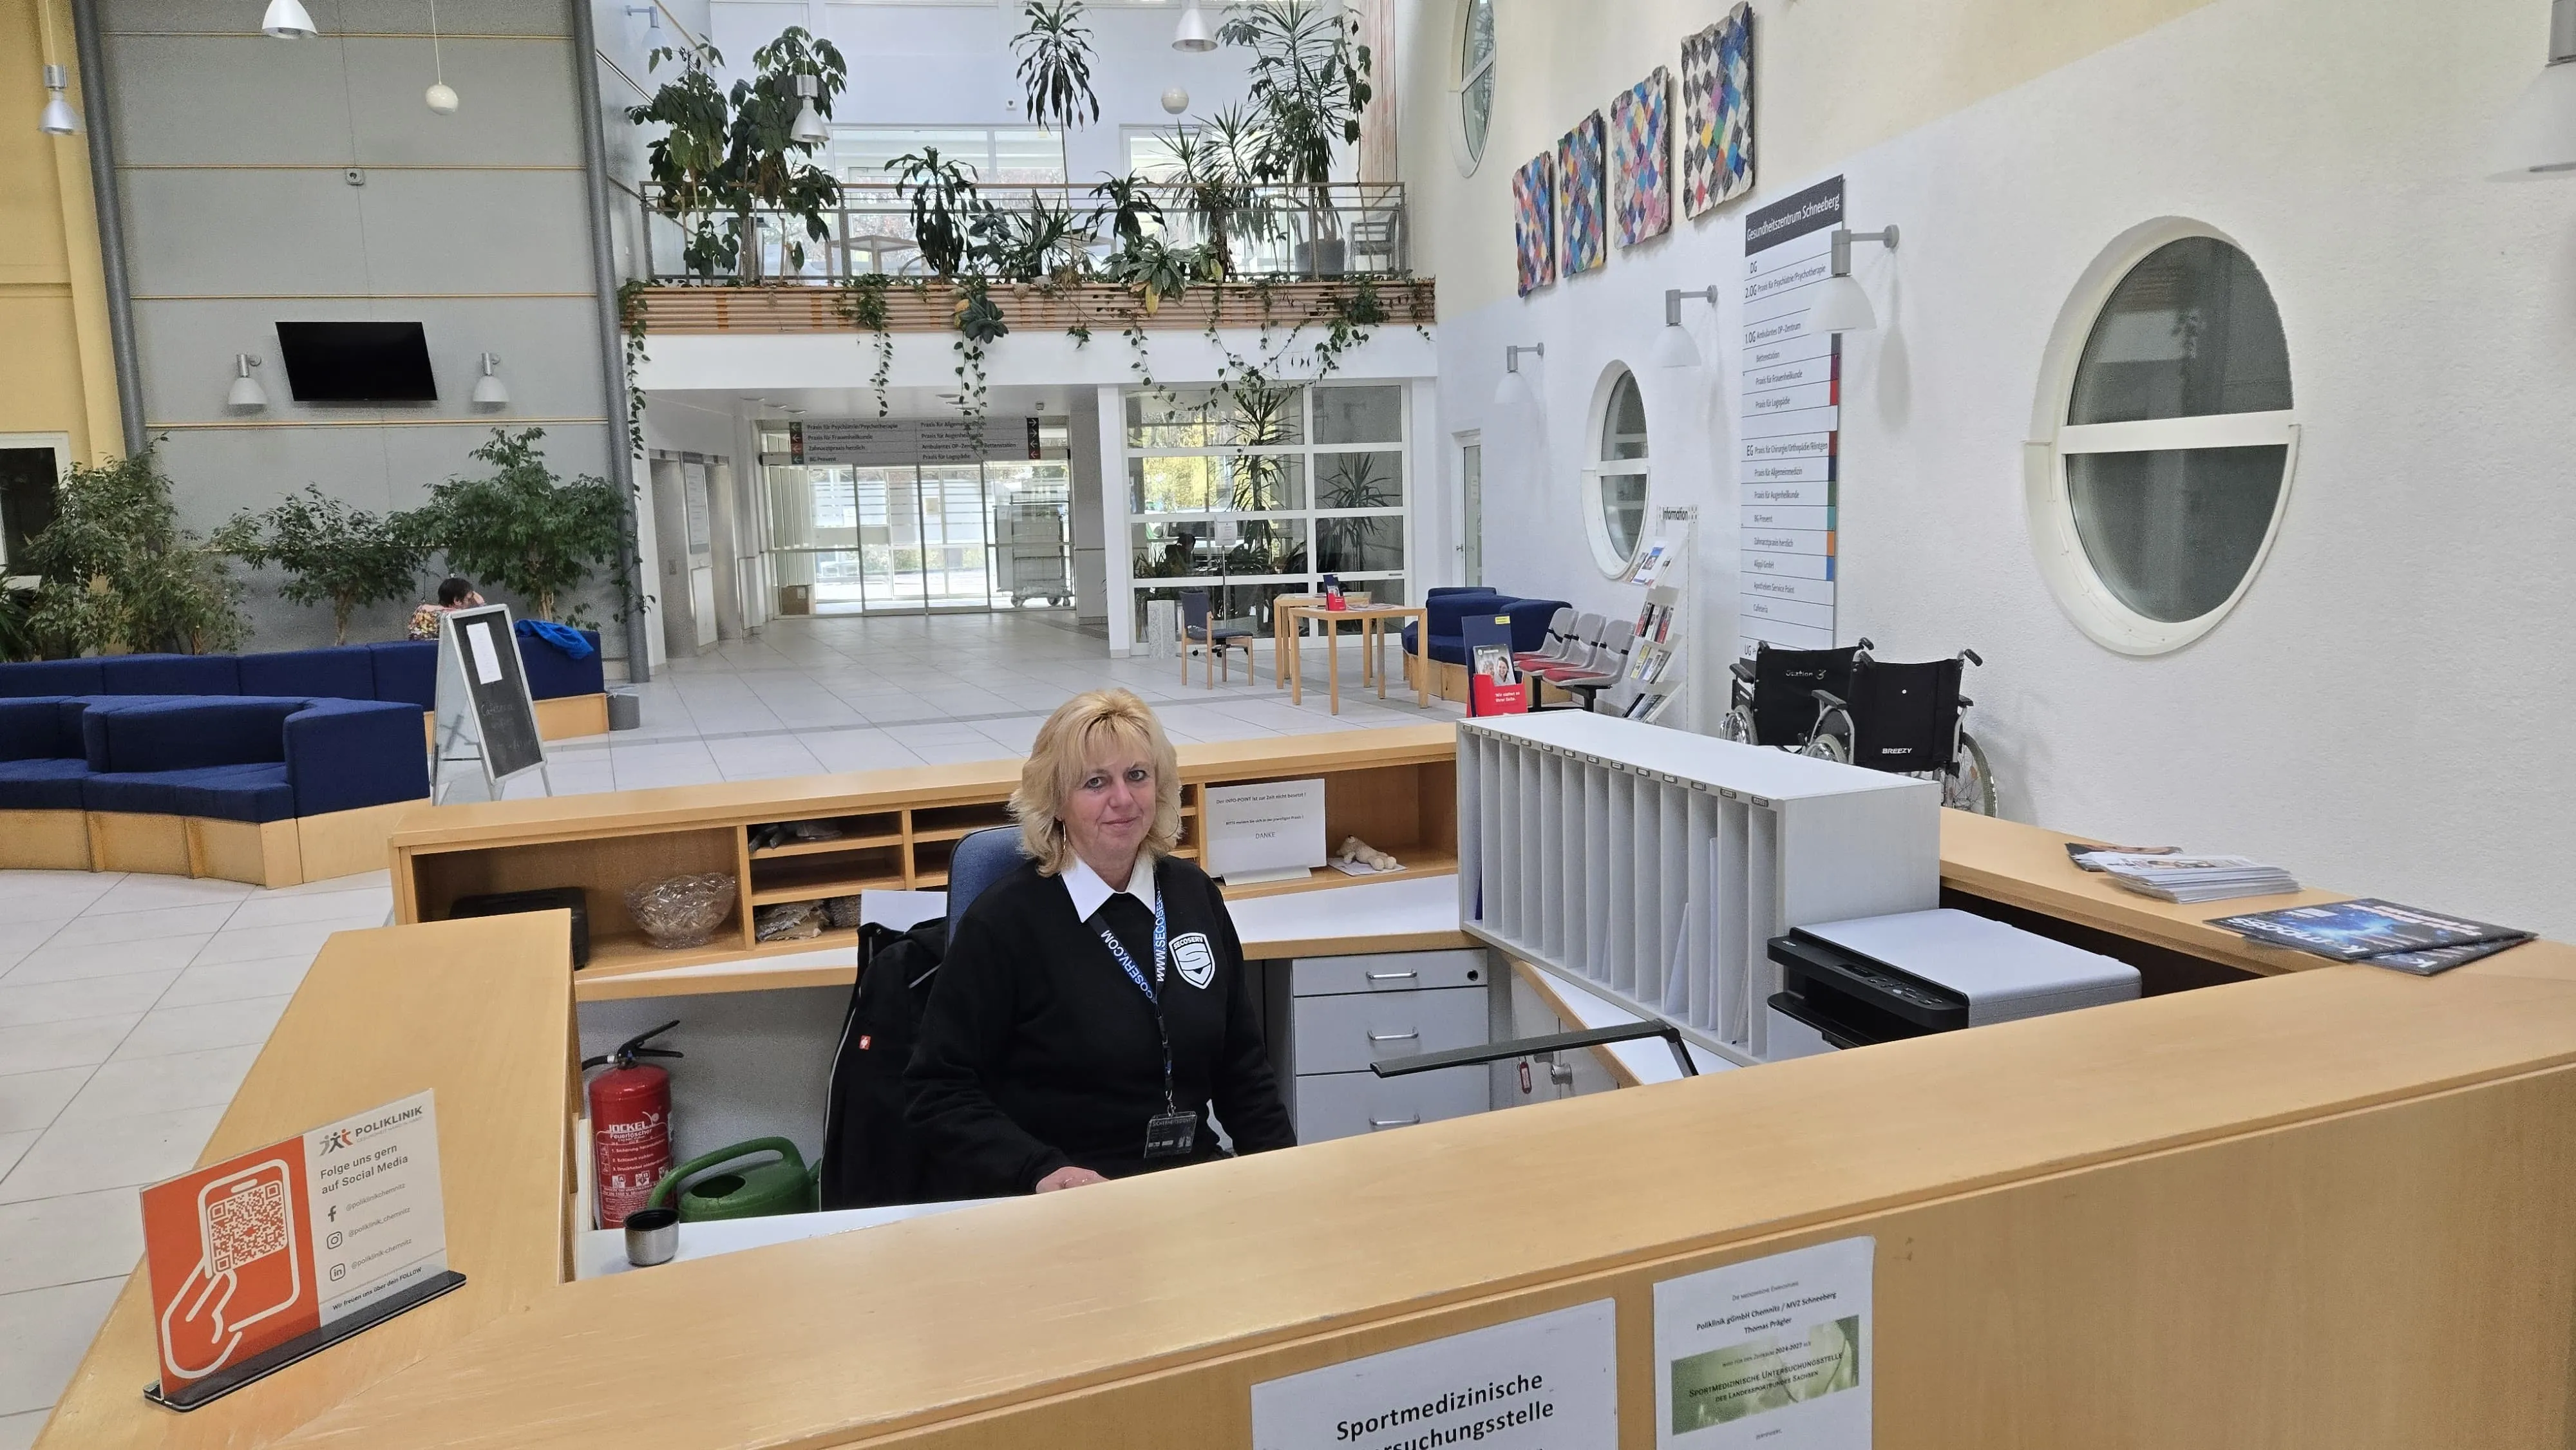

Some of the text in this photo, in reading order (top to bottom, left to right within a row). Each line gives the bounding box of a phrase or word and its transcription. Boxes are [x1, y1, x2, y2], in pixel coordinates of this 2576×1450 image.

[1747, 193, 1839, 241] Gesundheitszentrum Schneeberg
[1750, 261, 1757, 274] DG
[1745, 285, 1757, 298] 2.OG
[1745, 331, 1756, 344] 1.OG
[1756, 352, 1780, 362] Bettenstation
[1772, 370, 1803, 382] Frauenheilkunde
[1772, 396, 1790, 408] Logopädie
[1747, 445, 1754, 457] EG
[1771, 466, 1803, 478] Allgemeinmedizin
[1771, 490, 1799, 501] Augenheilkunde
[1663, 507, 1689, 522] Information
[1772, 583, 1785, 592] Service
[1745, 645, 1751, 655] UG
[1173, 937, 1204, 950] SECOSERV
[355, 1106, 423, 1136] POLIKLINIK
[609, 1121, 646, 1133] JOCKEL
[320, 1145, 397, 1179] Folge uns gern
[322, 1156, 408, 1194] auf Social Media
[346, 1183, 406, 1212] @poliklinikchemnitz
[348, 1207, 411, 1238] @poliklinik_chemnitz
[351, 1238, 412, 1269] @poliklinik-chemnitz
[332, 1267, 422, 1310] Wir freuen uns über dein FOLLOW
[1696, 1292, 1837, 1331] Poliklinik gGmbH Chemnitz / MVZ Schneeberg
[1744, 1317, 1792, 1334] Thomas Prägler
[1776, 1342, 1802, 1354] 2024-2027
[1337, 1373, 1543, 1442] Sportmedizinische
